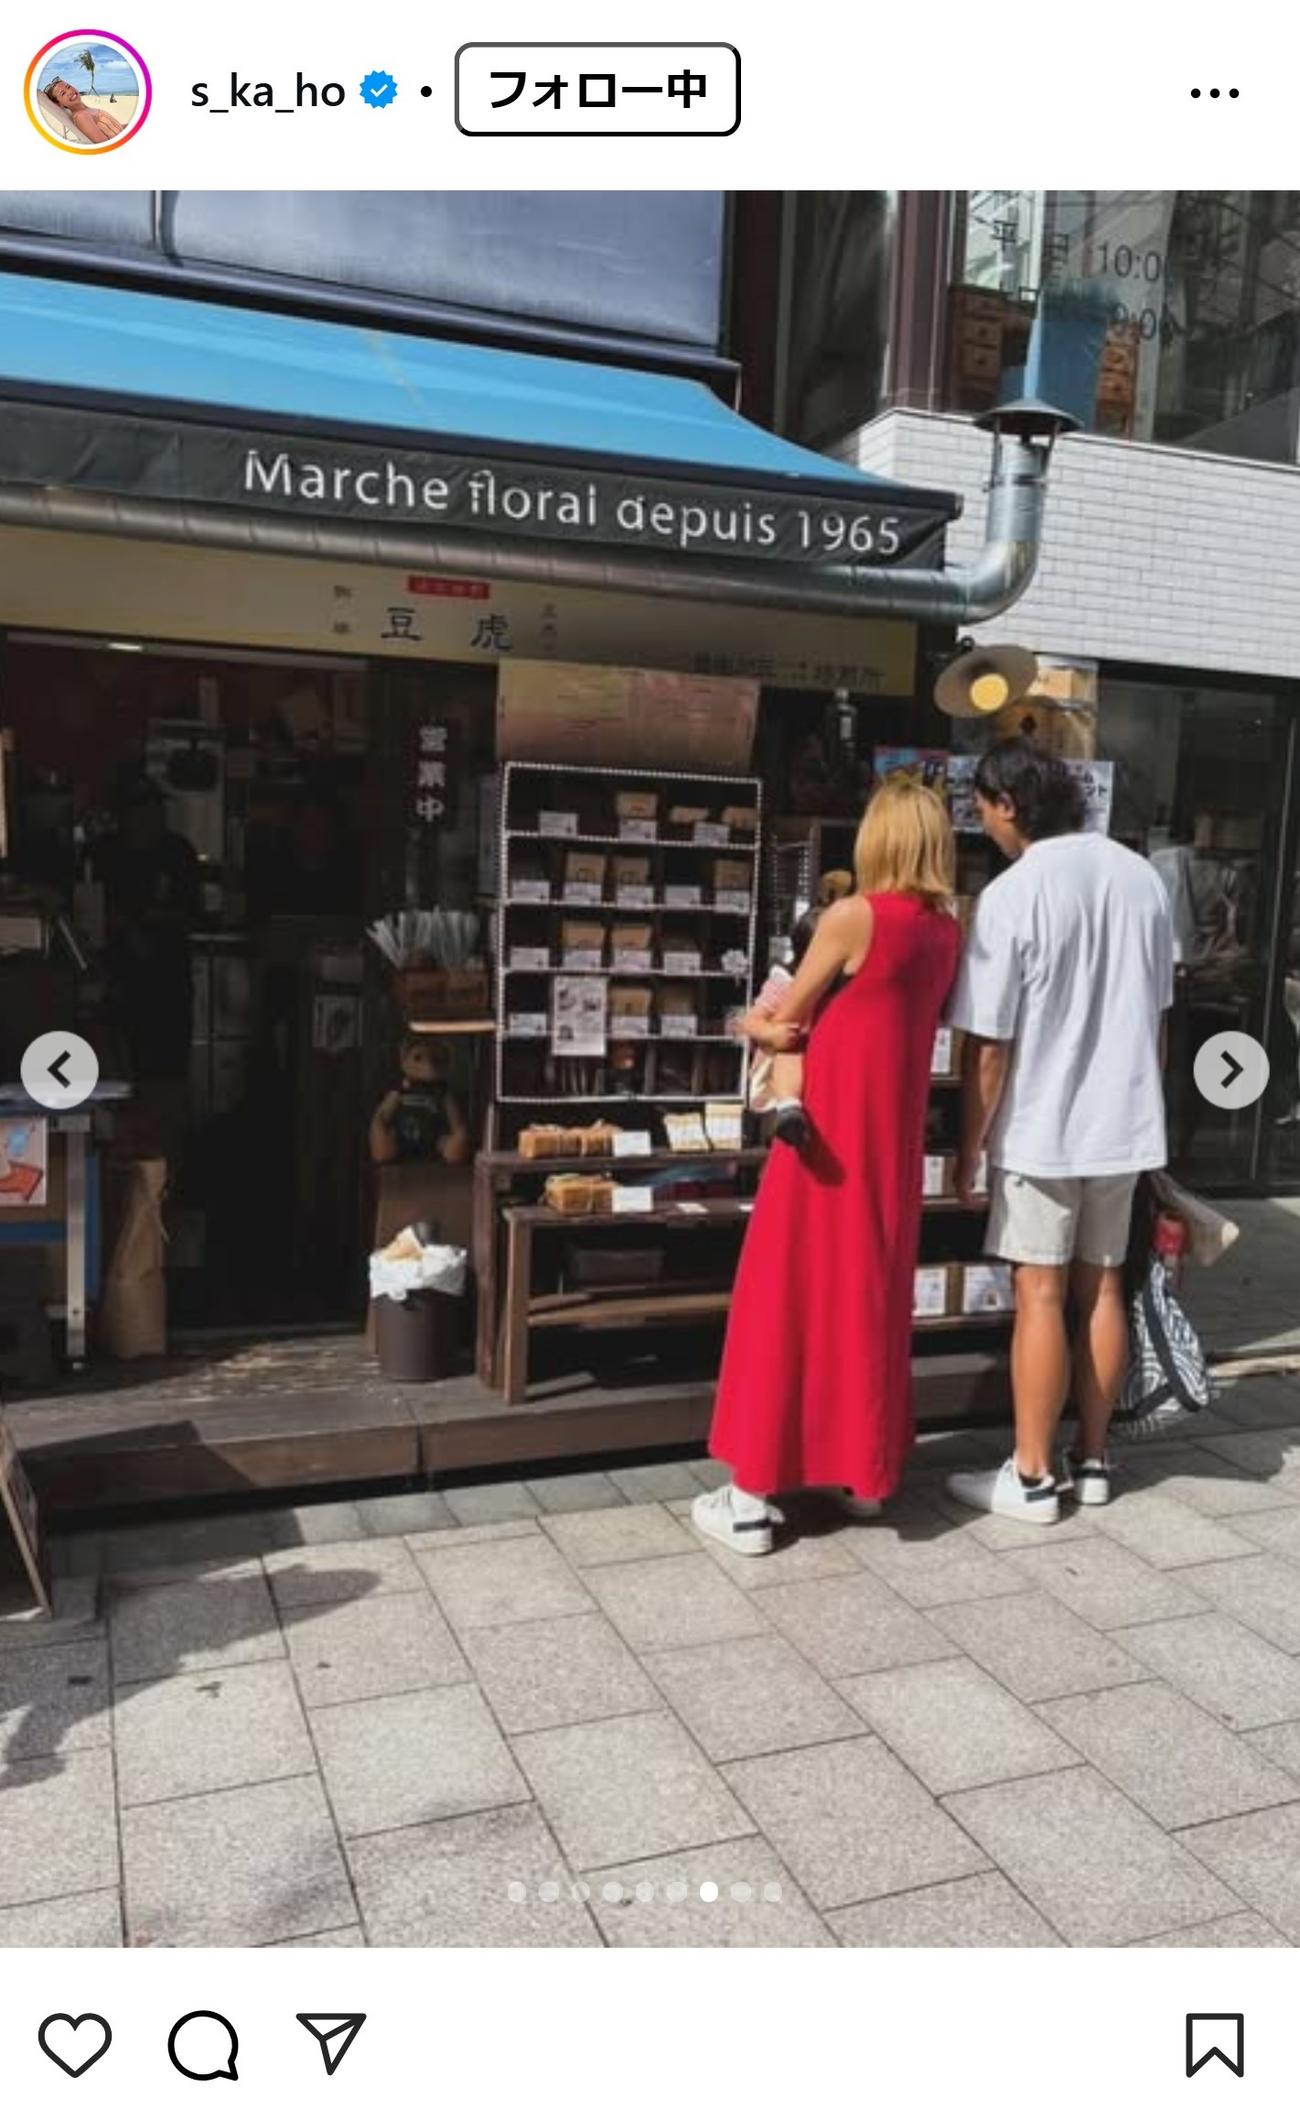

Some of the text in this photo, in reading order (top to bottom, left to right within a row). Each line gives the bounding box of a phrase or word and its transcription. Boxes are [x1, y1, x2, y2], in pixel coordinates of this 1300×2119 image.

[245, 451, 900, 554] Marche floral depuis 1965
[381, 606, 513, 652] 豆虎
